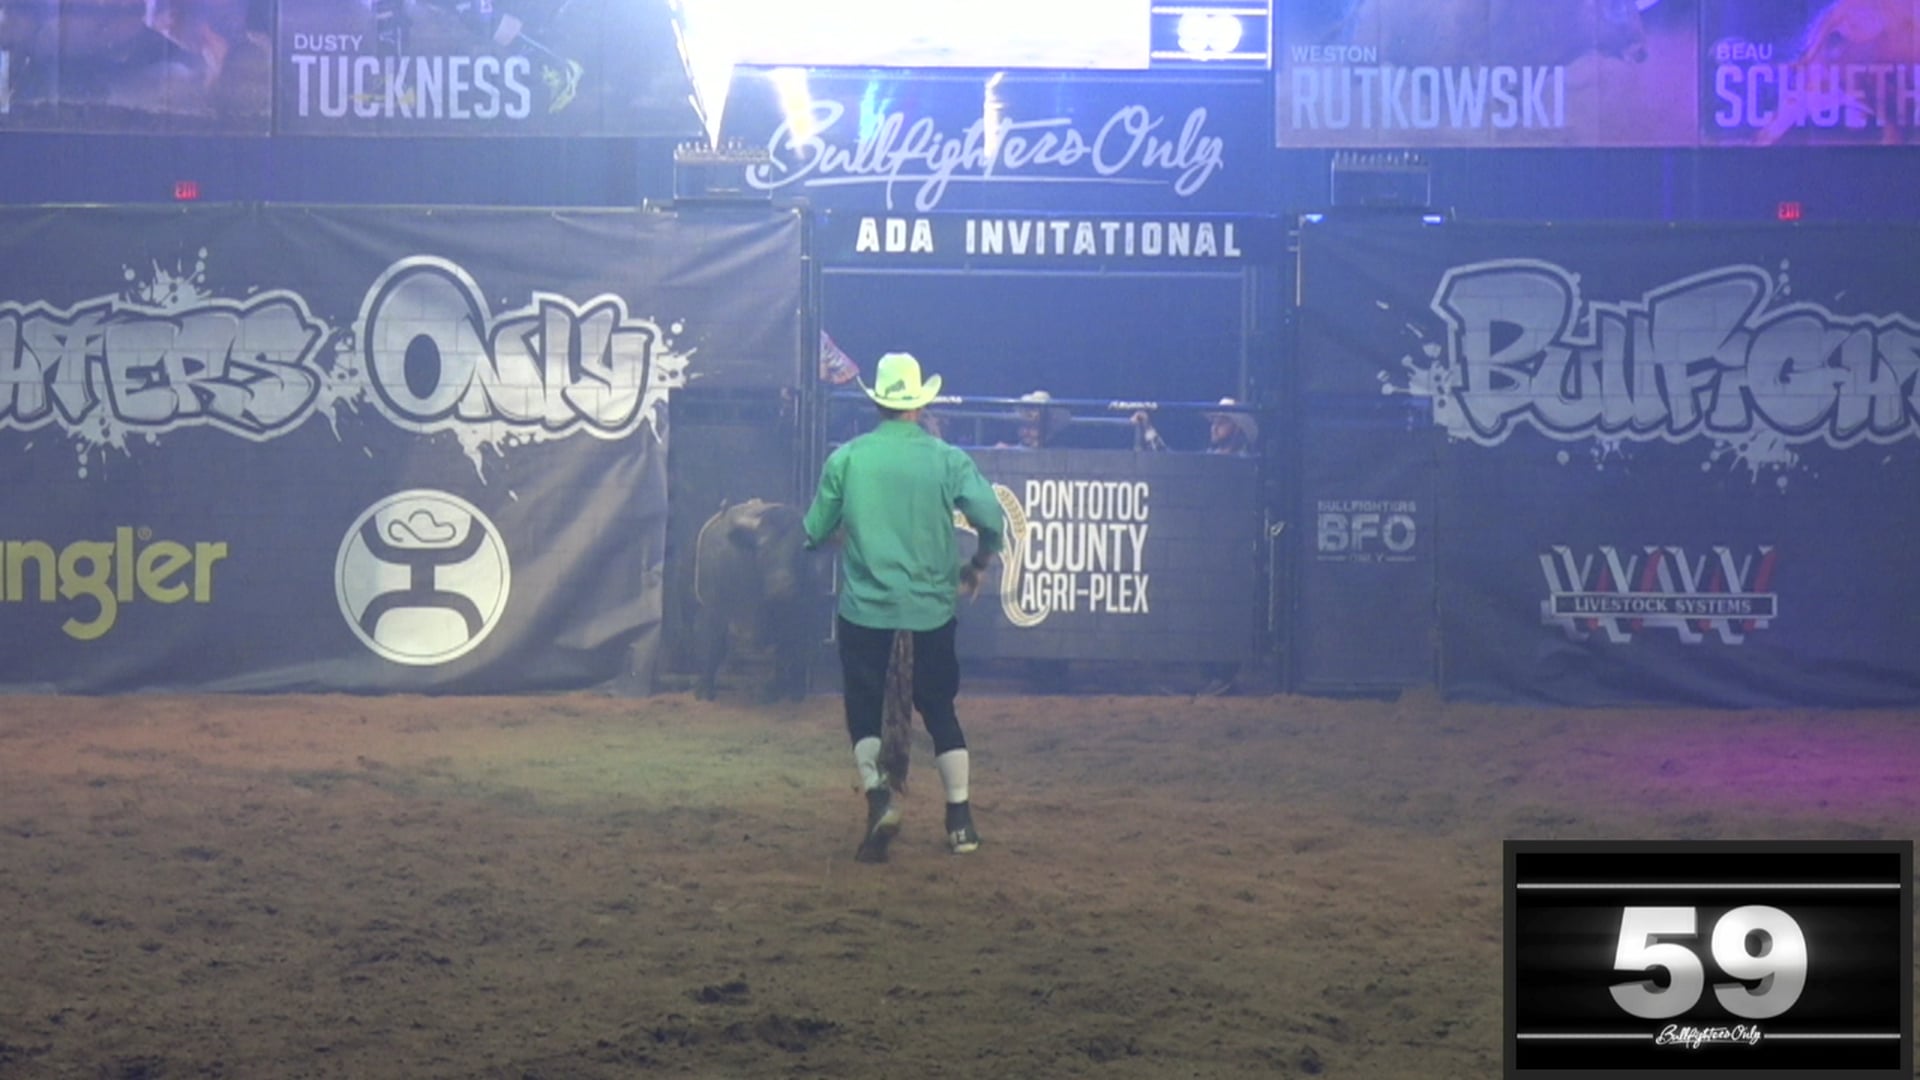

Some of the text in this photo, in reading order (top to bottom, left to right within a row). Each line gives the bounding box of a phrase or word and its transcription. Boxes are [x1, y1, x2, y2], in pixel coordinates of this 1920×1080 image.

[294, 35, 363, 51] DUSTY
[1291, 46, 1377, 63] WESTON
[1717, 43, 1773, 60] BEAU
[291, 55, 531, 119] TUCKNESS
[1291, 65, 1568, 129] RUTKOWSKI
[1091, 94, 1224, 197] Only
[855, 216, 1241, 257] ADA INVITATIONAL
[1025, 479, 1149, 521] PONTOTOC
[1023, 521, 1149, 572] COUNTY
[1318, 513, 1416, 552] BFO
[0, 526, 227, 640] ngler
[1021, 571, 1149, 613] AGRI-PLEX
[1574, 596, 1751, 615] LIVESTOCK SYSTEMS
